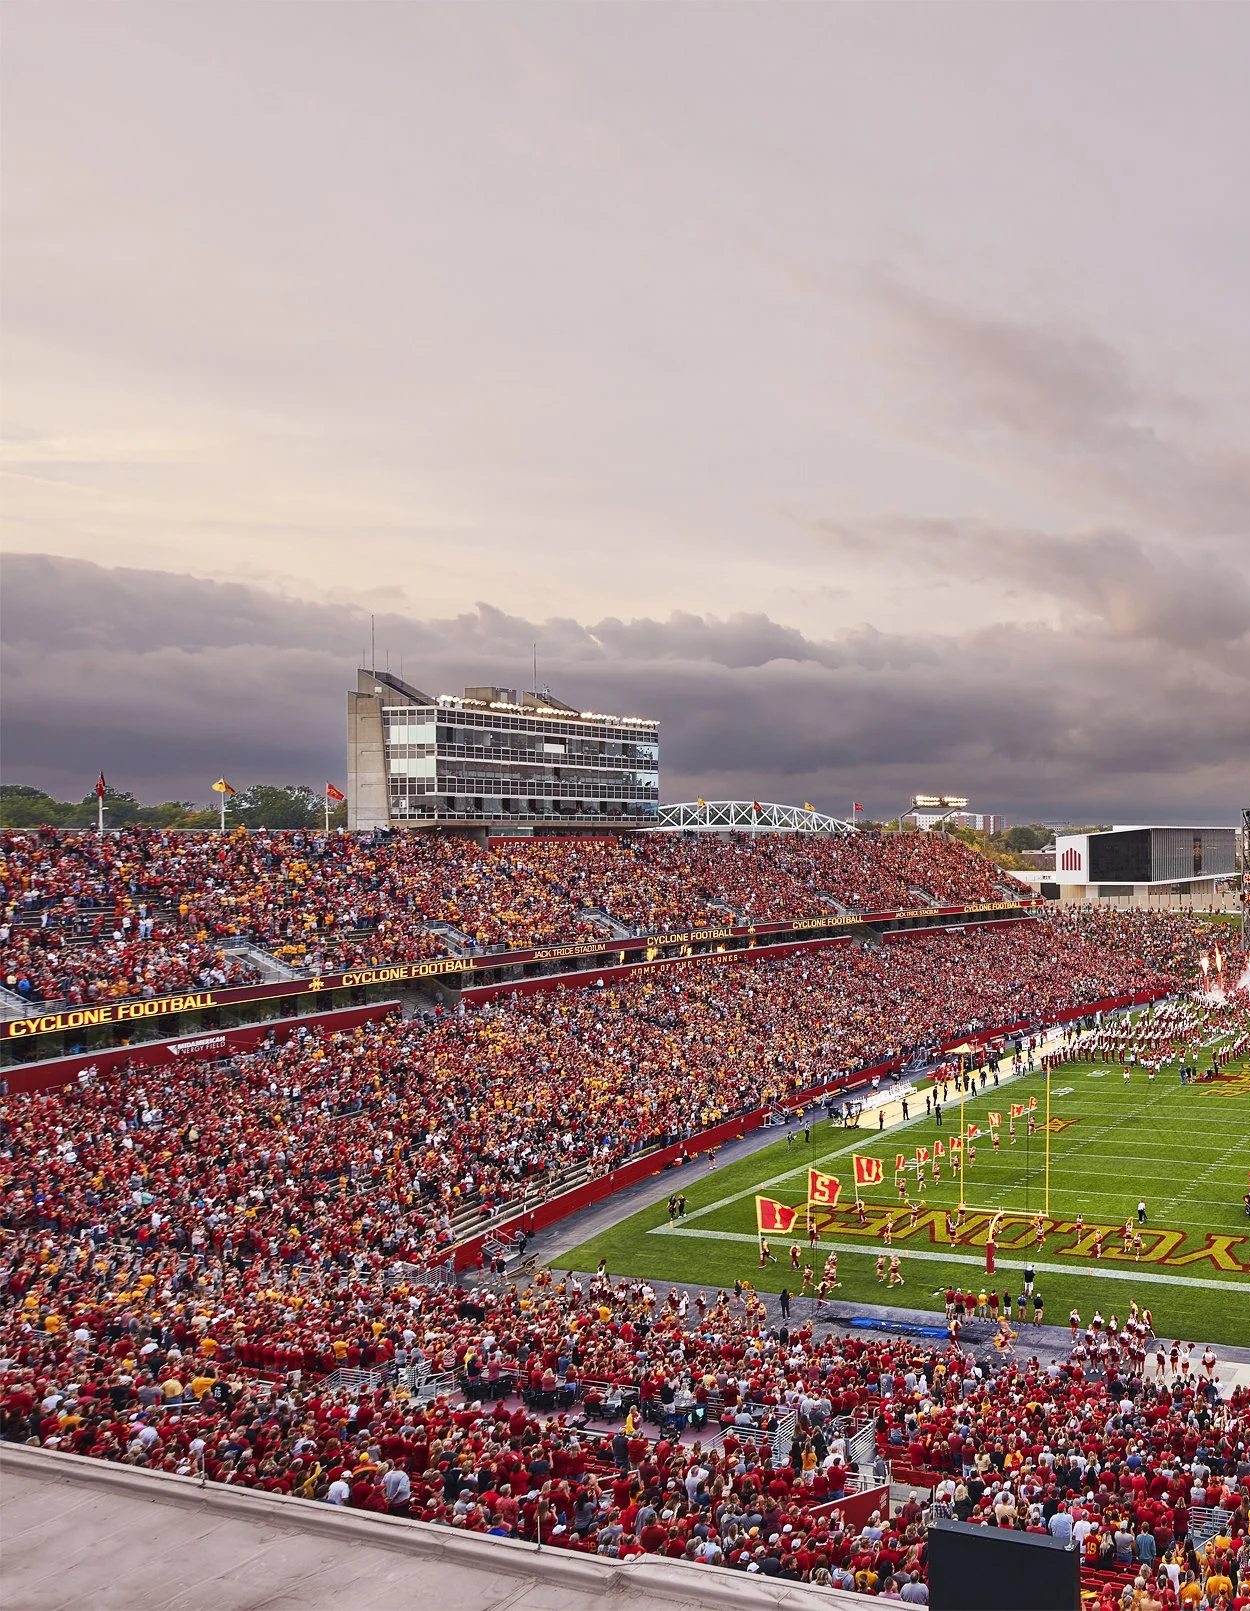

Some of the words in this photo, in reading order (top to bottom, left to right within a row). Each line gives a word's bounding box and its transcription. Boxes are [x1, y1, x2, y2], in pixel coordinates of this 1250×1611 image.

[964, 903, 992, 913] CYCLONE
[993, 901, 1021, 912] FOOTBALL
[792, 917, 826, 930] CYCLONE
[828, 915, 864, 926] FOOTBALL
[647, 933, 688, 946] CYCLONE
[690, 928, 734, 941] FOOTBALL
[533, 950, 552, 959] JACK
[553, 947, 574, 957] TRICE
[575, 943, 606, 955] STADIUM
[342, 966, 409, 987] CYCLONE
[411, 958, 478, 977] FOOTBALL
[631, 965, 656, 976] HOME
[660, 963, 671, 972] OF
[9, 1007, 114, 1037] CYCLONE
[117, 993, 218, 1020] FOOTBALL
[205, 1041, 226, 1051] FIELD
[862, 1157, 881, 1181] U
[815, 1176, 830, 1201] S
[1086, 1541, 1097, 1555] 19
